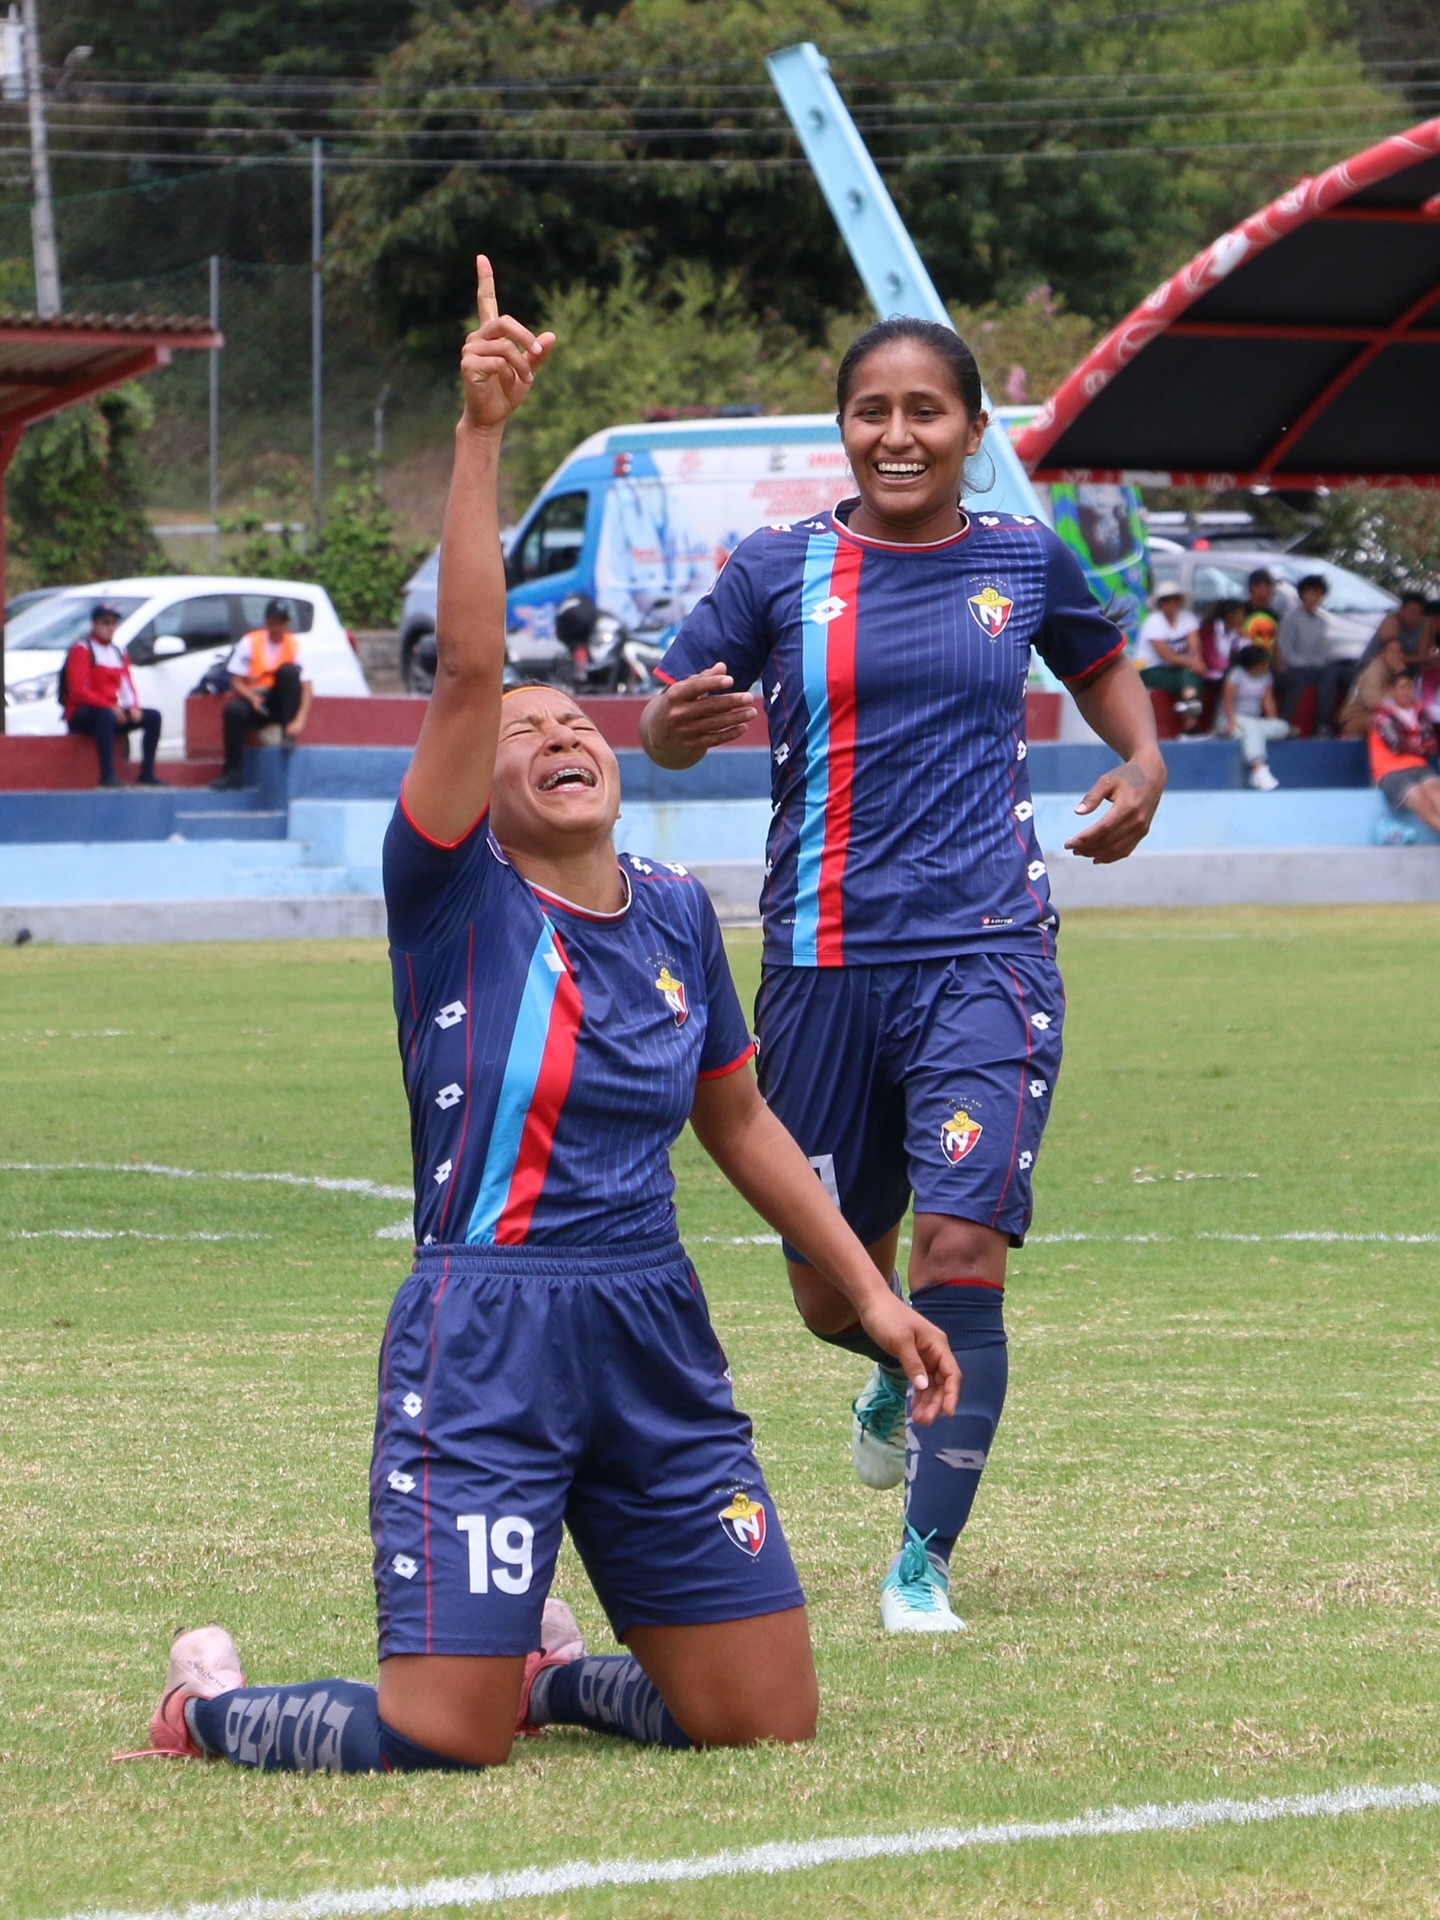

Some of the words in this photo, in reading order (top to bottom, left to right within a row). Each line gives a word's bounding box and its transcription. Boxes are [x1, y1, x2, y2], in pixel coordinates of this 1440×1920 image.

[979, 604, 1003, 627] N
[946, 1131, 970, 1152] N
[733, 1514, 760, 1543] N
[457, 1514, 534, 1595] 19
